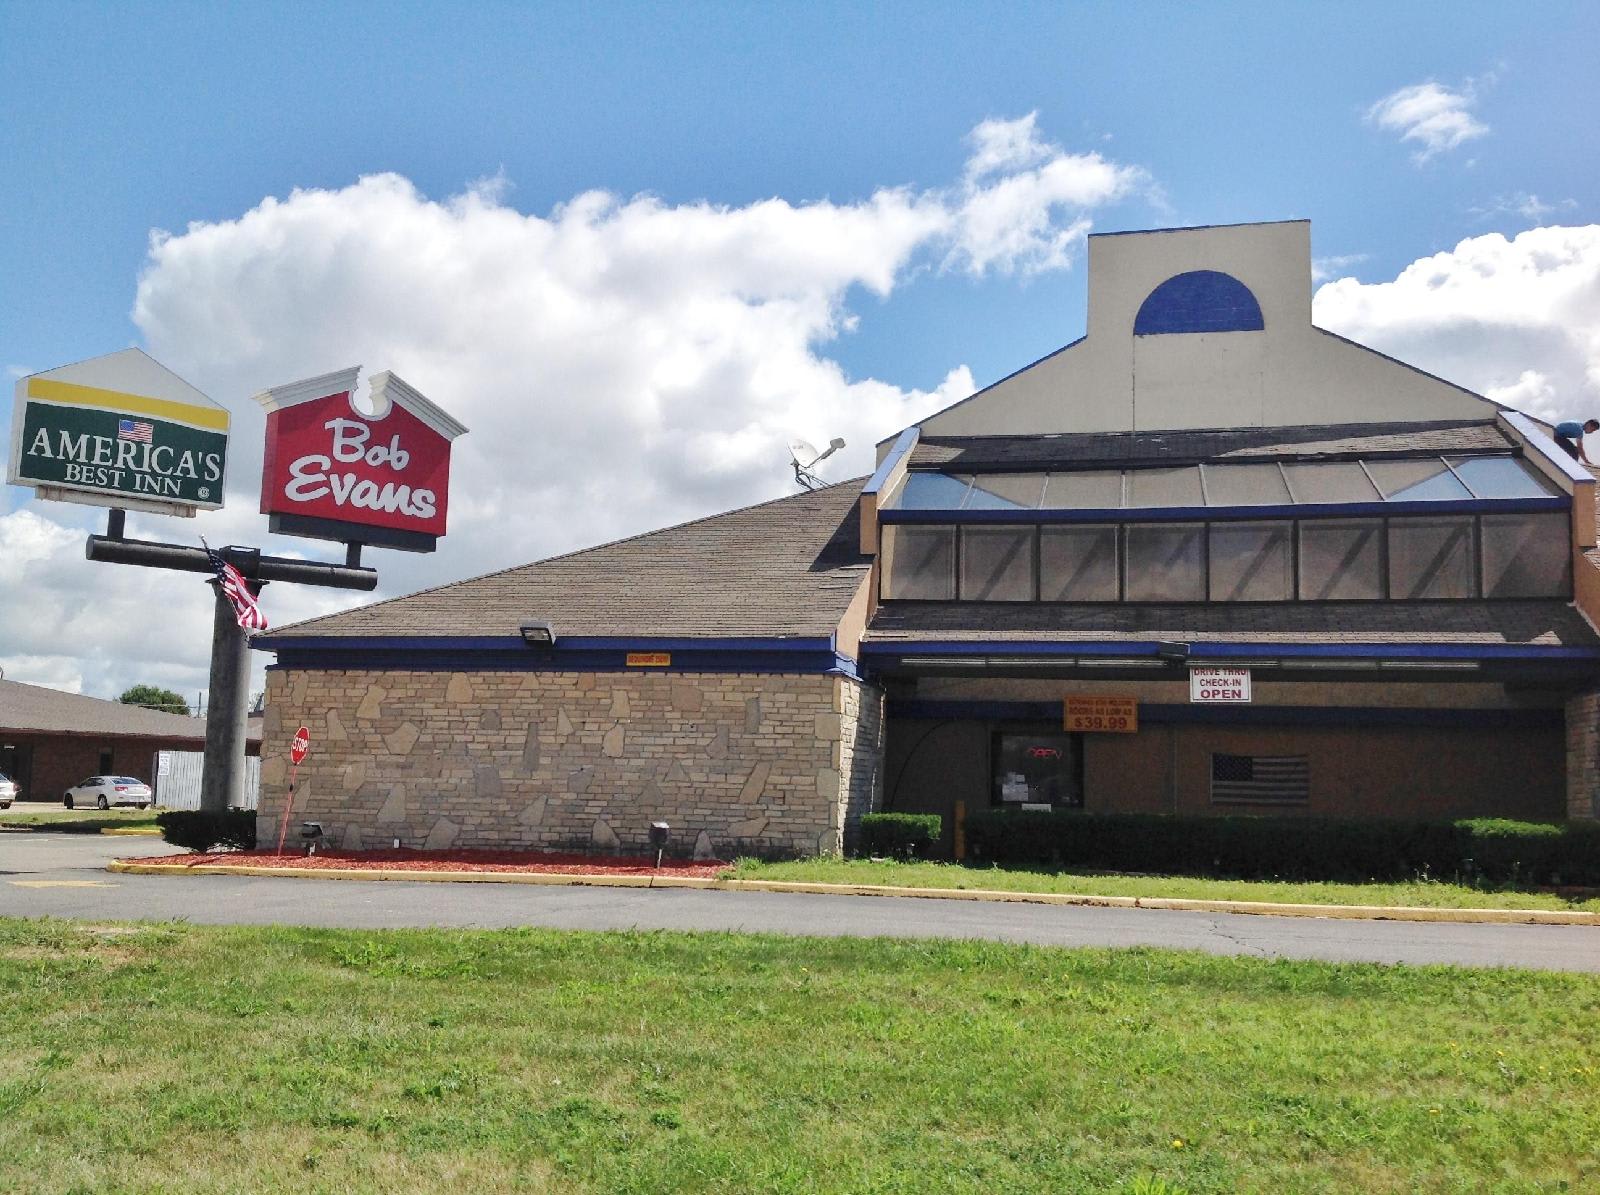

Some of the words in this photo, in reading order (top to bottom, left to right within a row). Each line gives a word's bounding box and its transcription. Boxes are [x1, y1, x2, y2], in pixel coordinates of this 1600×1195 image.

[324, 417, 410, 471] Bob
[27, 427, 221, 482] AMERICA'S
[64, 463, 126, 488] BEST
[133, 473, 182, 496] INN
[284, 454, 437, 519] Evans
[1194, 667, 1220, 676] DRIVE
[1199, 678, 1241, 687] CHECK-IN
[1200, 689, 1242, 699] OPEN
[1074, 716, 1128, 730] $39.99
[291, 736, 308, 753] STOP
